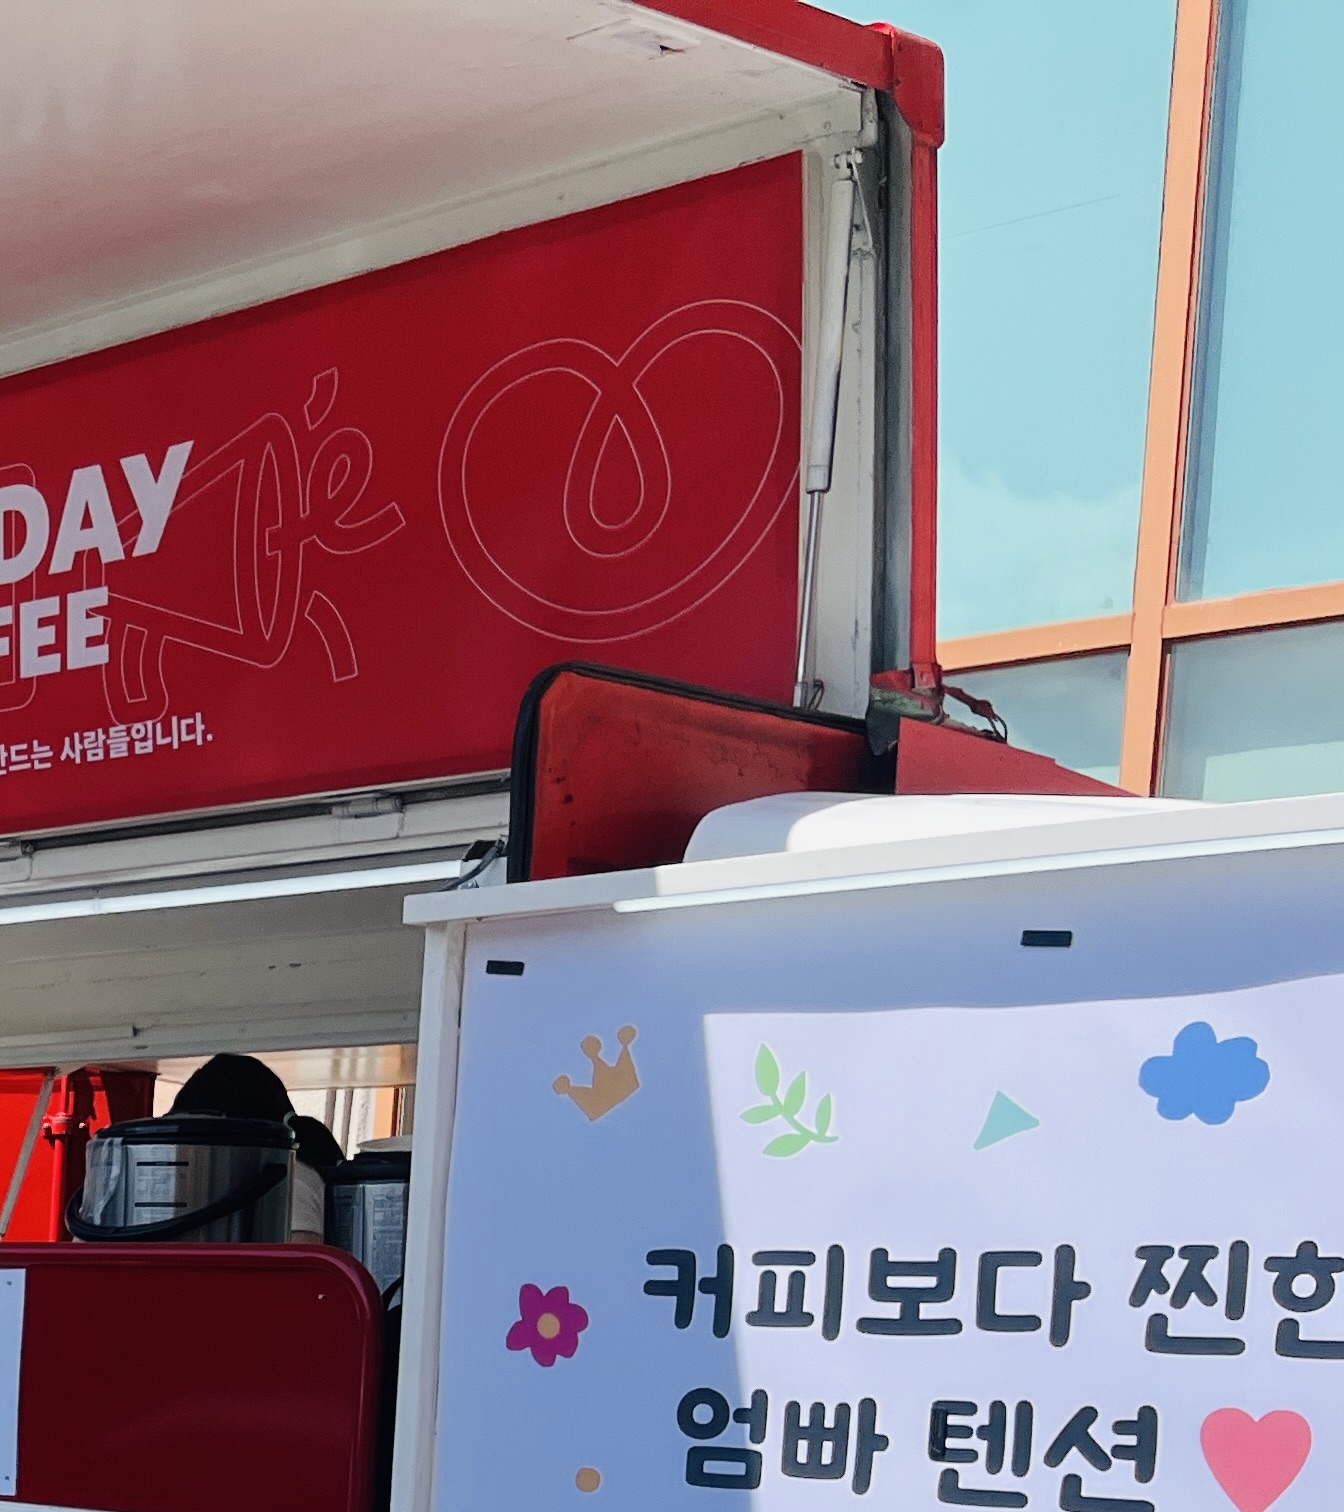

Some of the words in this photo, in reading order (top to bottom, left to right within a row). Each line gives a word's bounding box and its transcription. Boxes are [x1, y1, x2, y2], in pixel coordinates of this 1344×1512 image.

[60, 712, 214, 765] 사람들입니다.
[642, 1242, 1092, 1349] 커피보다
[676, 1386, 890, 1496] 엄빠
